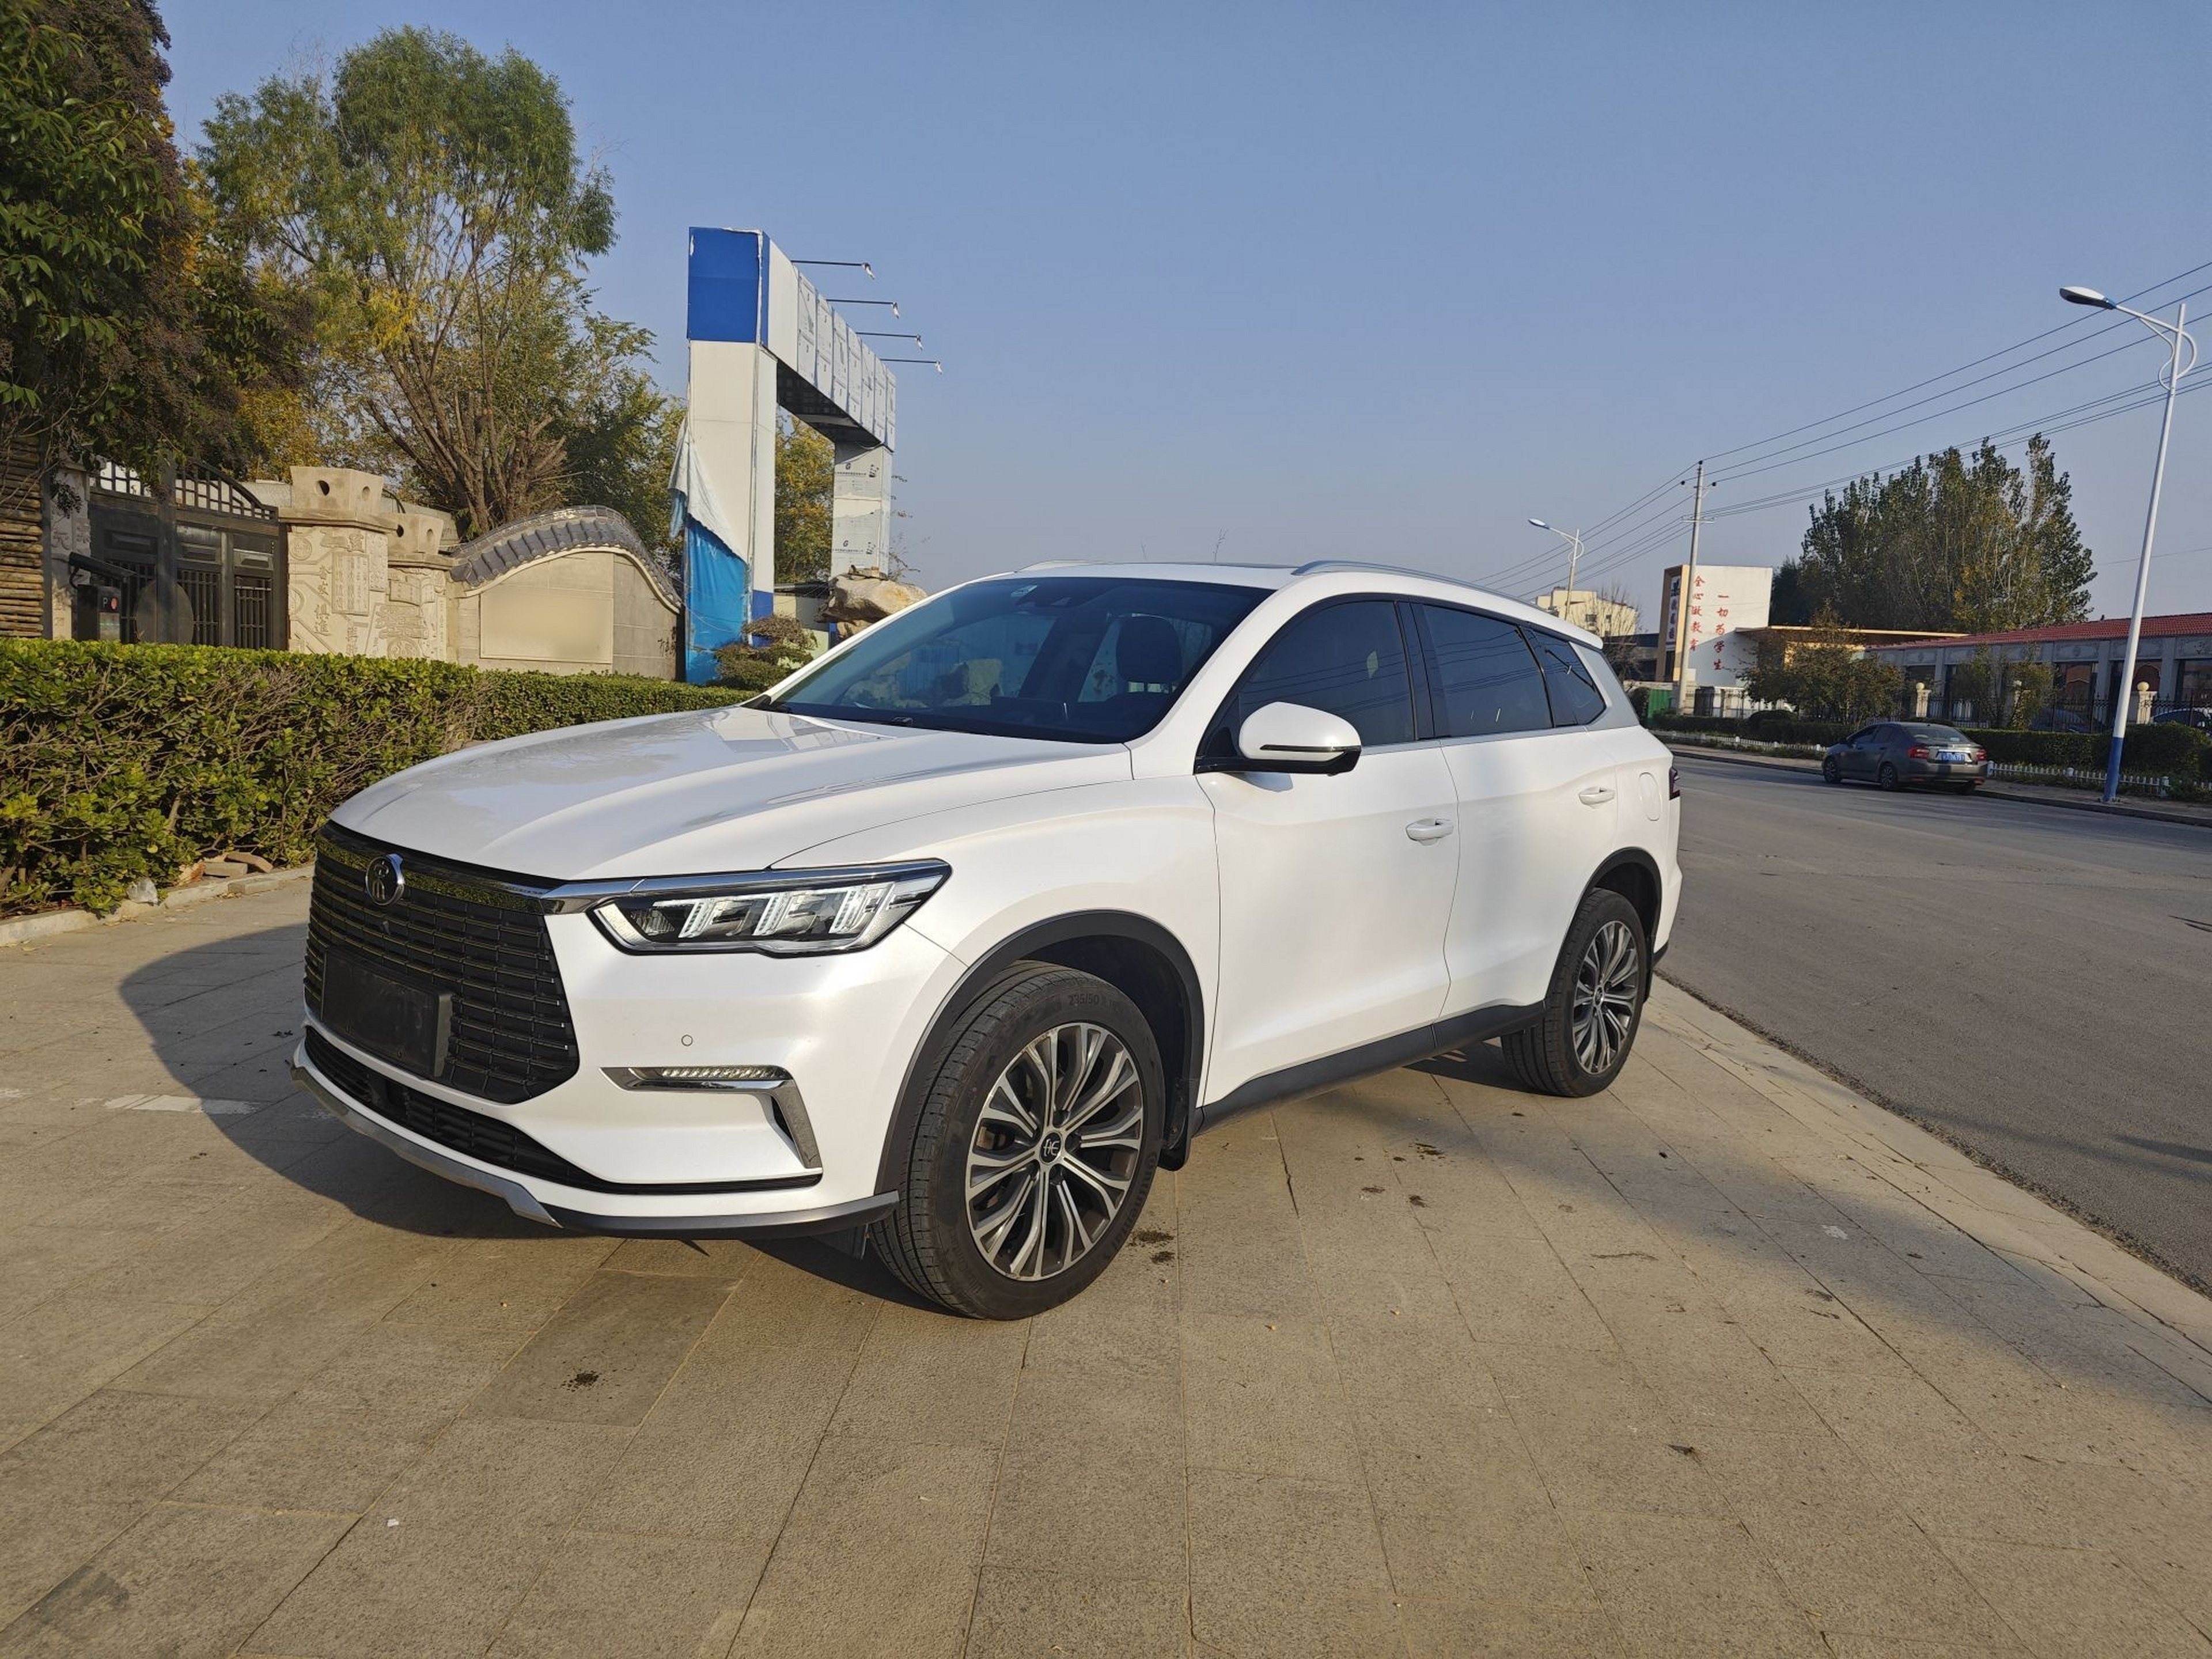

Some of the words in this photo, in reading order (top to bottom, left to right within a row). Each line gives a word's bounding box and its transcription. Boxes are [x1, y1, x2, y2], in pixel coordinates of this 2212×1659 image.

[1689, 575, 1706, 652] 全心做教育
[1713, 594, 1729, 671] 一切为学生
[1068, 994, 1100, 1006] 235/50
